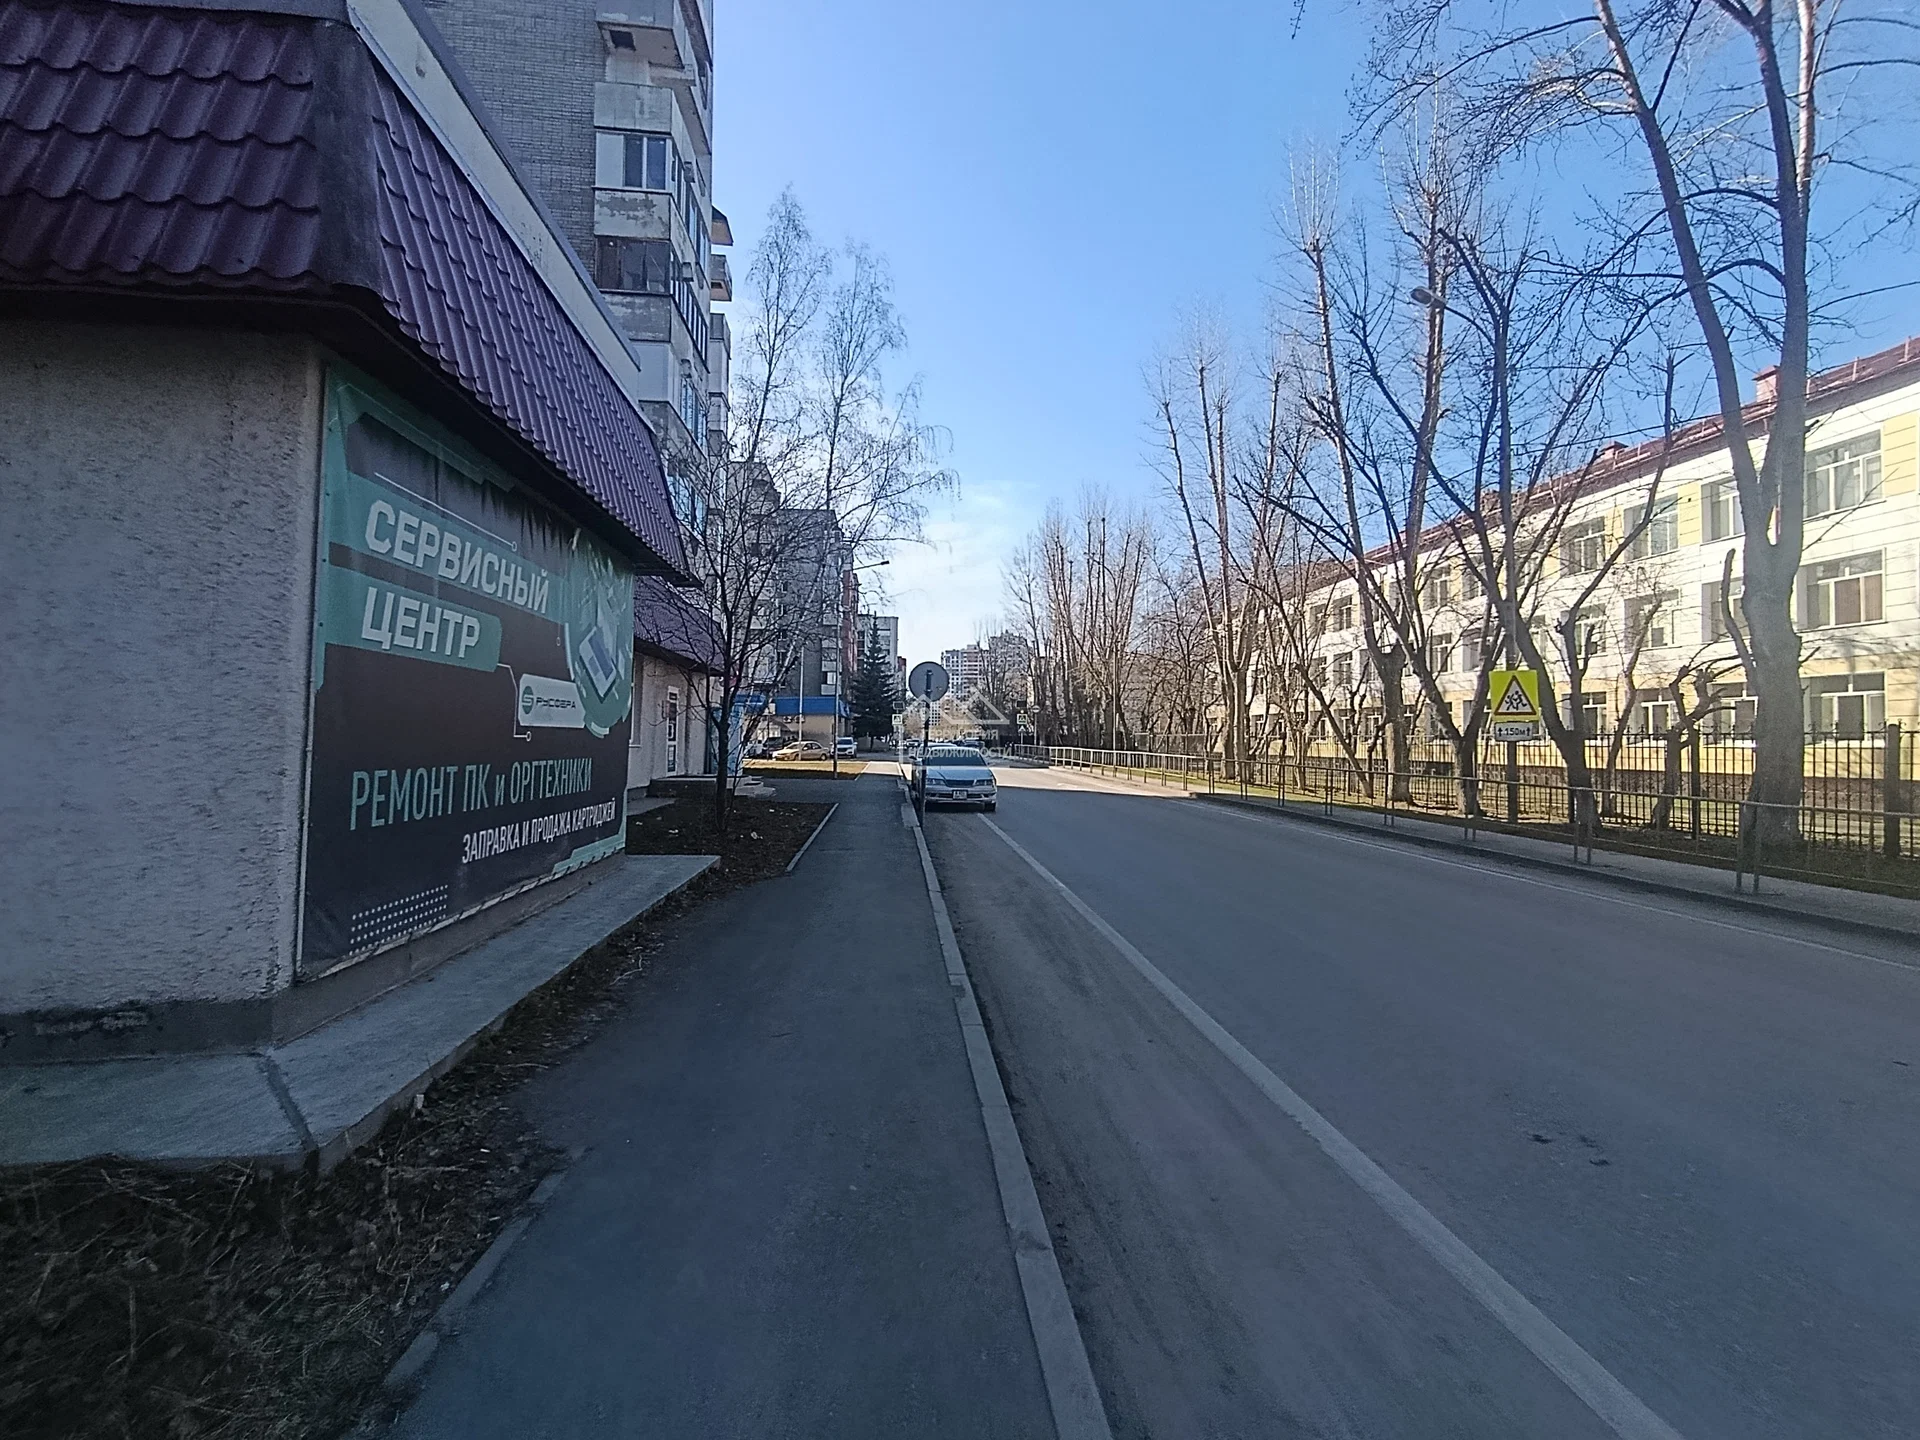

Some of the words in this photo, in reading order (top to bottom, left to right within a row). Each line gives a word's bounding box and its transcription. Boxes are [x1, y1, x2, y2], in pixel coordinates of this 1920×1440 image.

[365, 500, 549, 614] СЕРВИСНЫЙ
[361, 586, 481, 659] ЦЕНТР
[350, 766, 458, 831] РЕМОНТ
[463, 764, 491, 812] ПК
[510, 757, 593, 804] ОРГТЕХНИКИ
[462, 823, 520, 864] ЗАПРАВКА
[521, 821, 530, 846] И
[530, 811, 571, 843] ПРОДАЖА
[571, 797, 616, 832] КАРТРИДЖЕЙ
